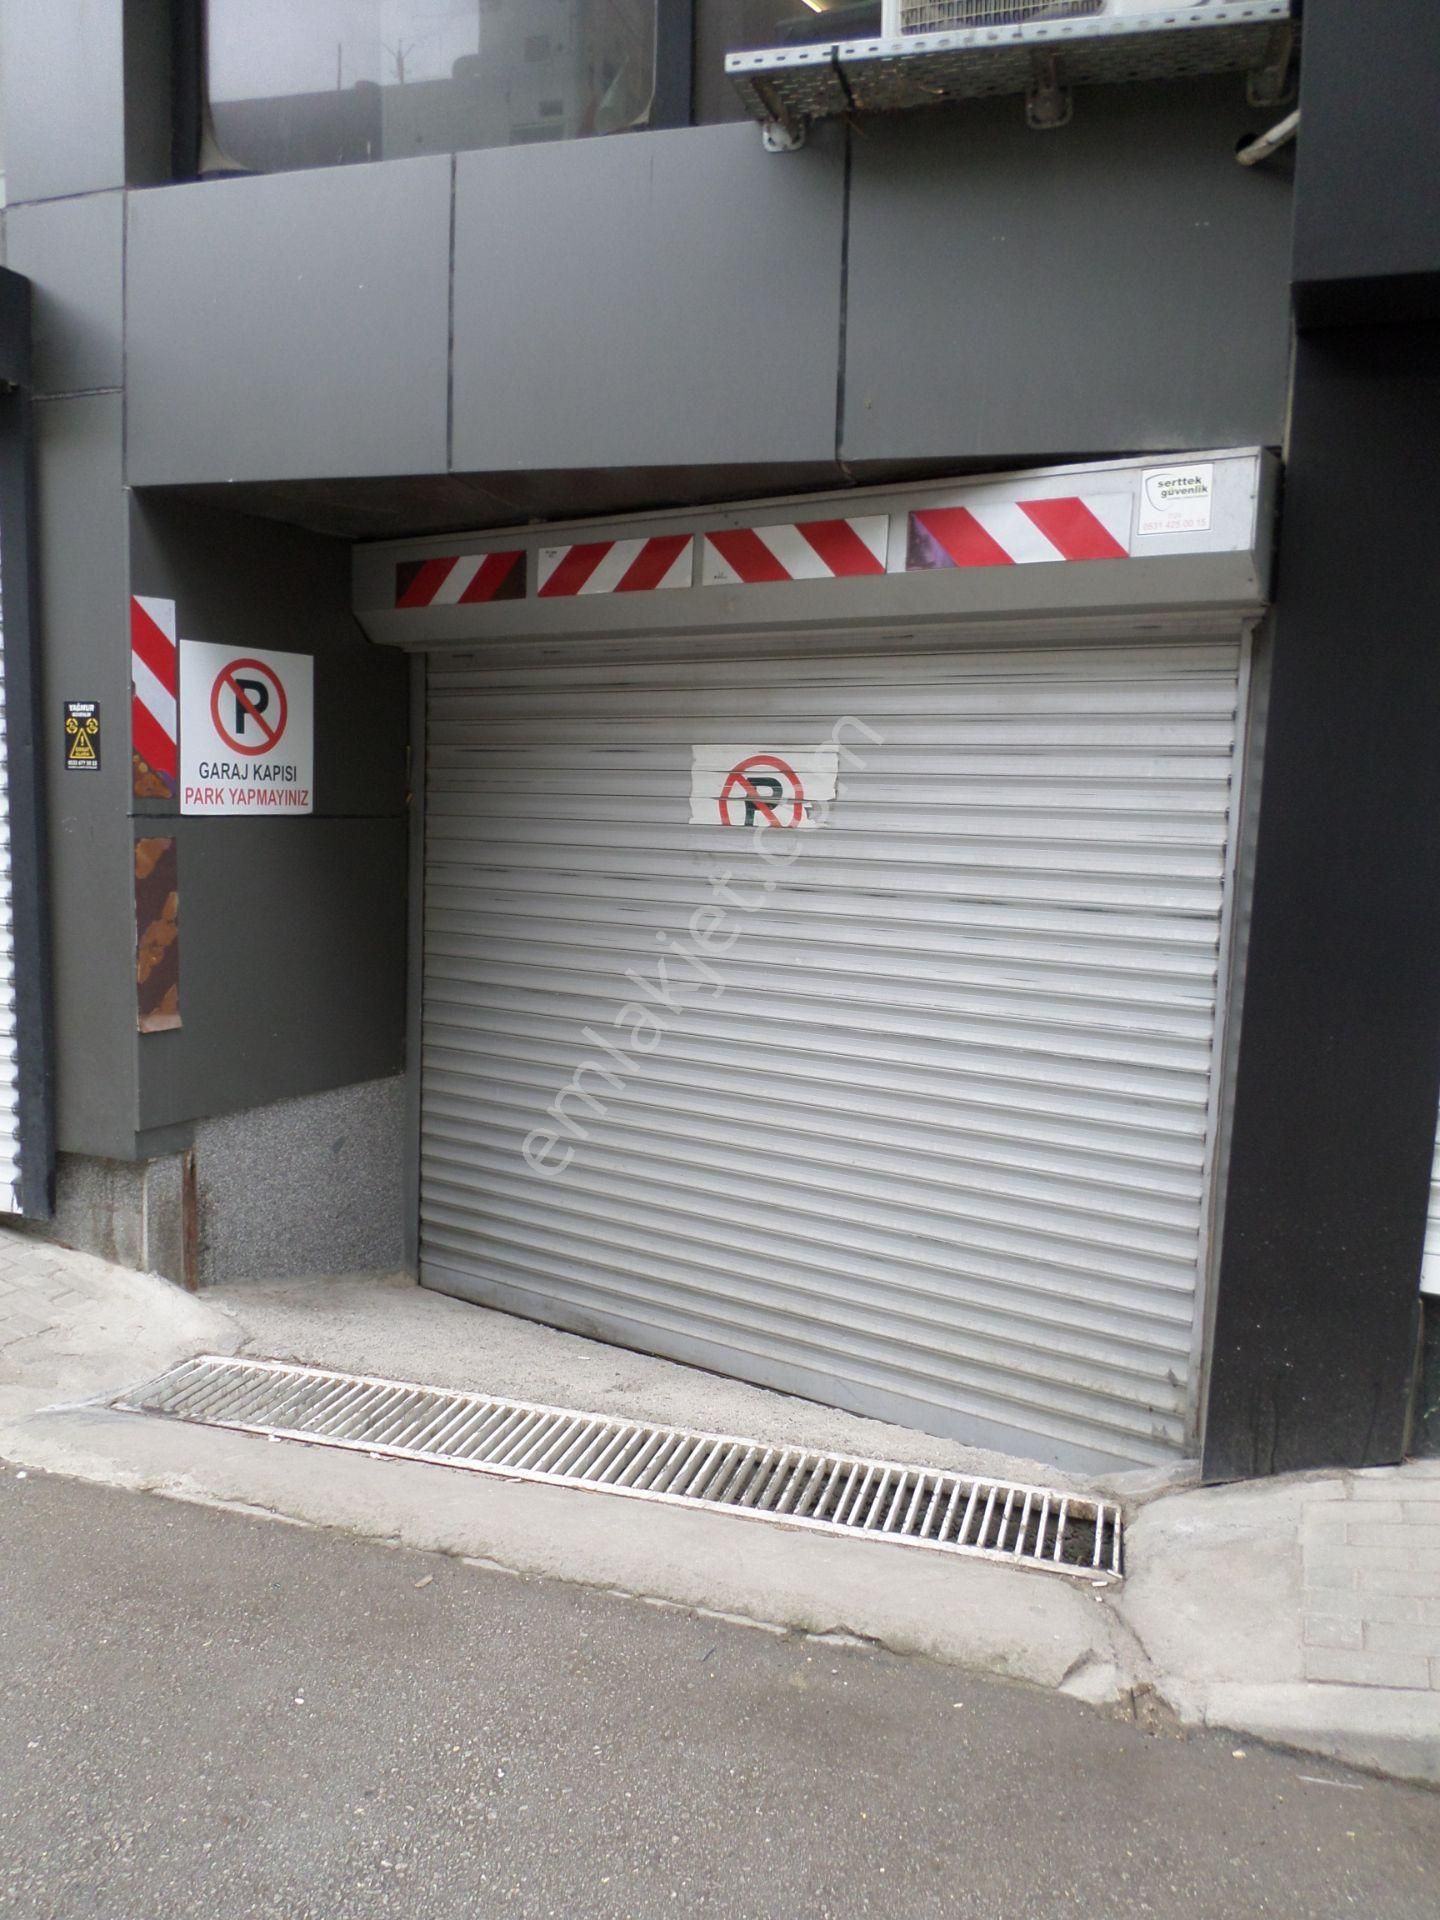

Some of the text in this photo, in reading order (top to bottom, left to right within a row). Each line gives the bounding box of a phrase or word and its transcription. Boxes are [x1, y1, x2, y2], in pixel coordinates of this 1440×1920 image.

[1157, 475, 1202, 488] serttek
[1160, 485, 1208, 498] güvenlik
[199, 761, 297, 782] GARAJ KAPISI
[185, 787, 309, 807] PARK YAPMAYINIZ
